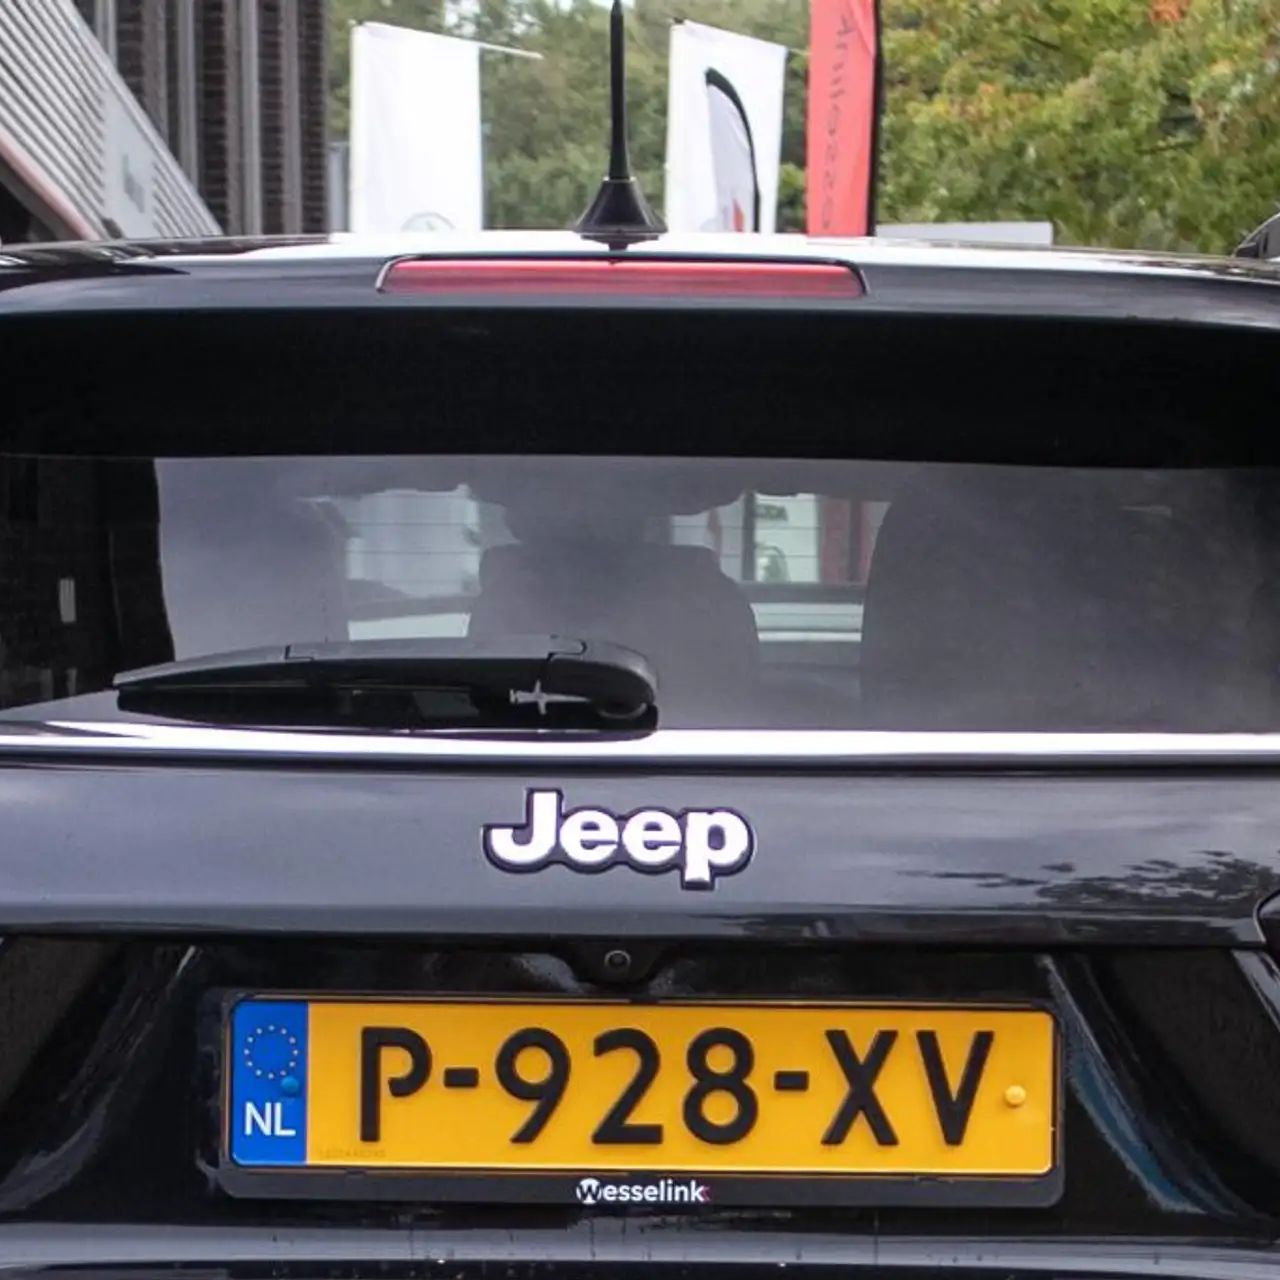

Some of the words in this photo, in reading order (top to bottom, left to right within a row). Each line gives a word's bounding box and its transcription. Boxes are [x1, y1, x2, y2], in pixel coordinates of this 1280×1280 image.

[485, 788, 753, 890] Jeep
[244, 1101, 297, 1137] NL
[359, 1026, 997, 1147] P-928-XV
[576, 1177, 710, 1205] Wesselink
